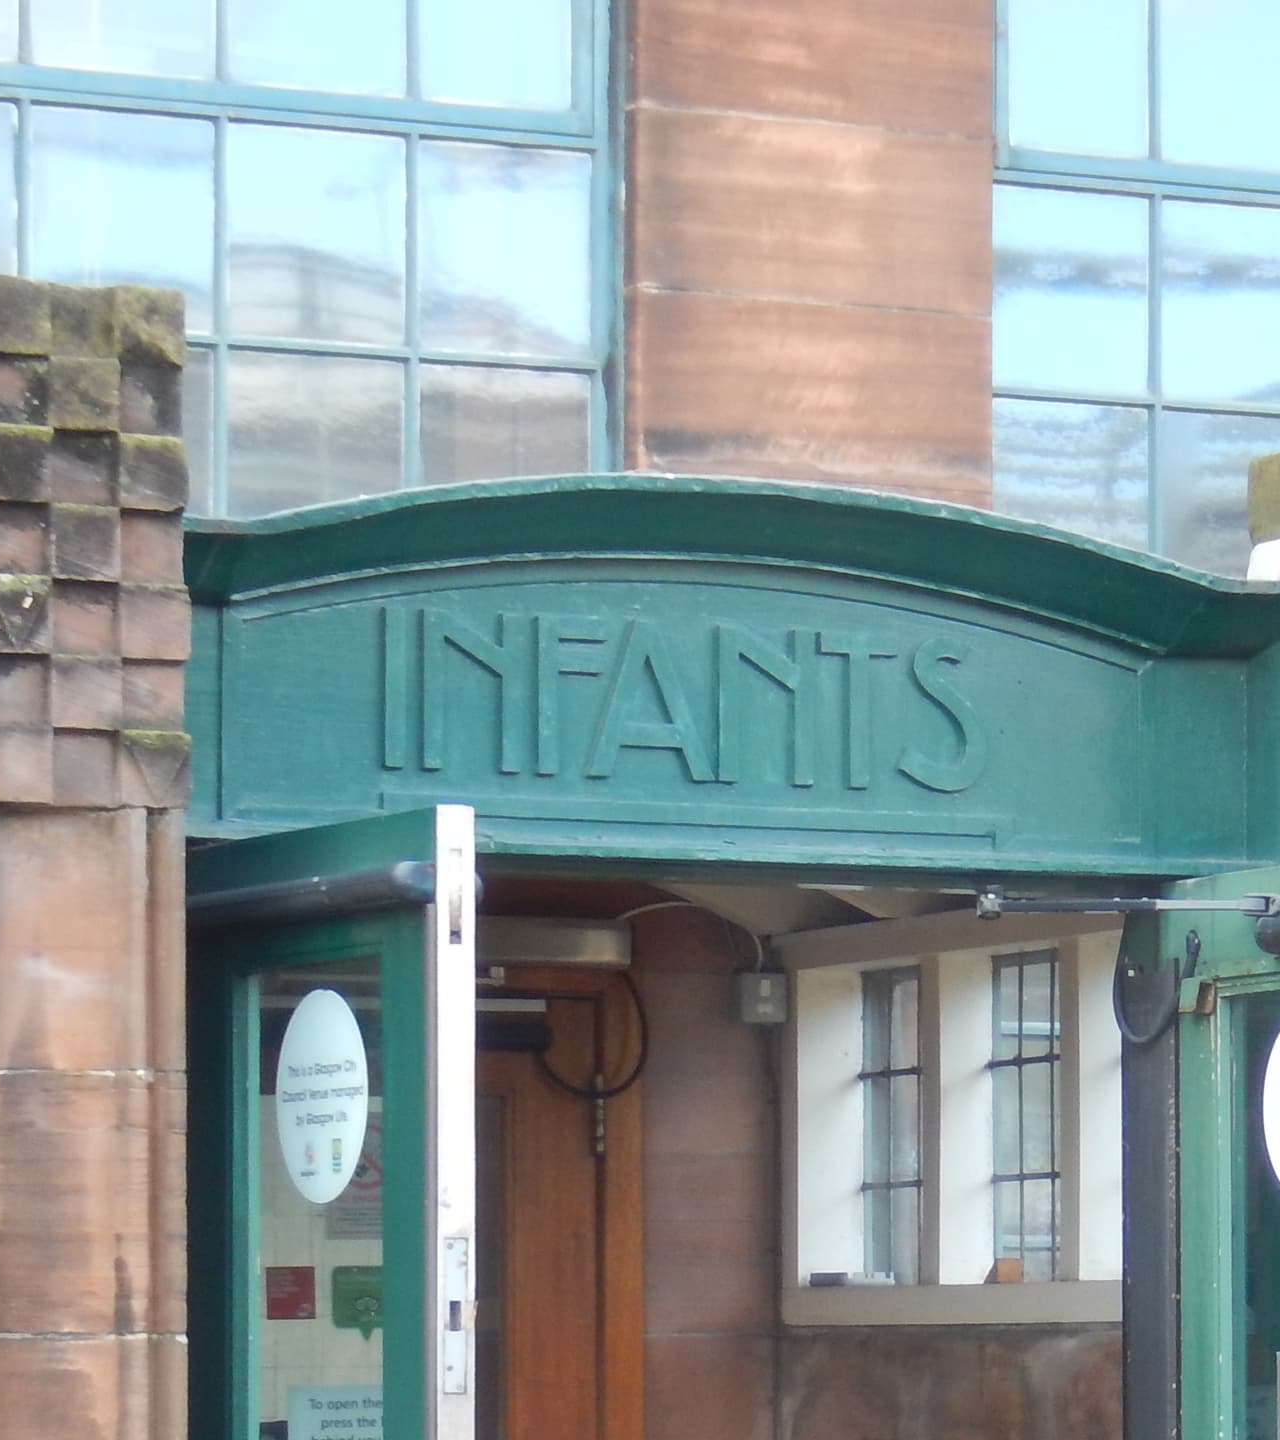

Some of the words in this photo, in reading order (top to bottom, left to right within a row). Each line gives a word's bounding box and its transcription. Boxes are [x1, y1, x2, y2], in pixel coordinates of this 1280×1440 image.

[380, 605, 990, 793] INFANTS
[314, 1062, 342, 1077] Glasgow
[306, 1112, 334, 1127] Glasgow
[309, 1398, 323, 1410] To
[327, 1399, 358, 1410] open
[320, 1418, 353, 1430] press
[357, 1416, 377, 1427] the
